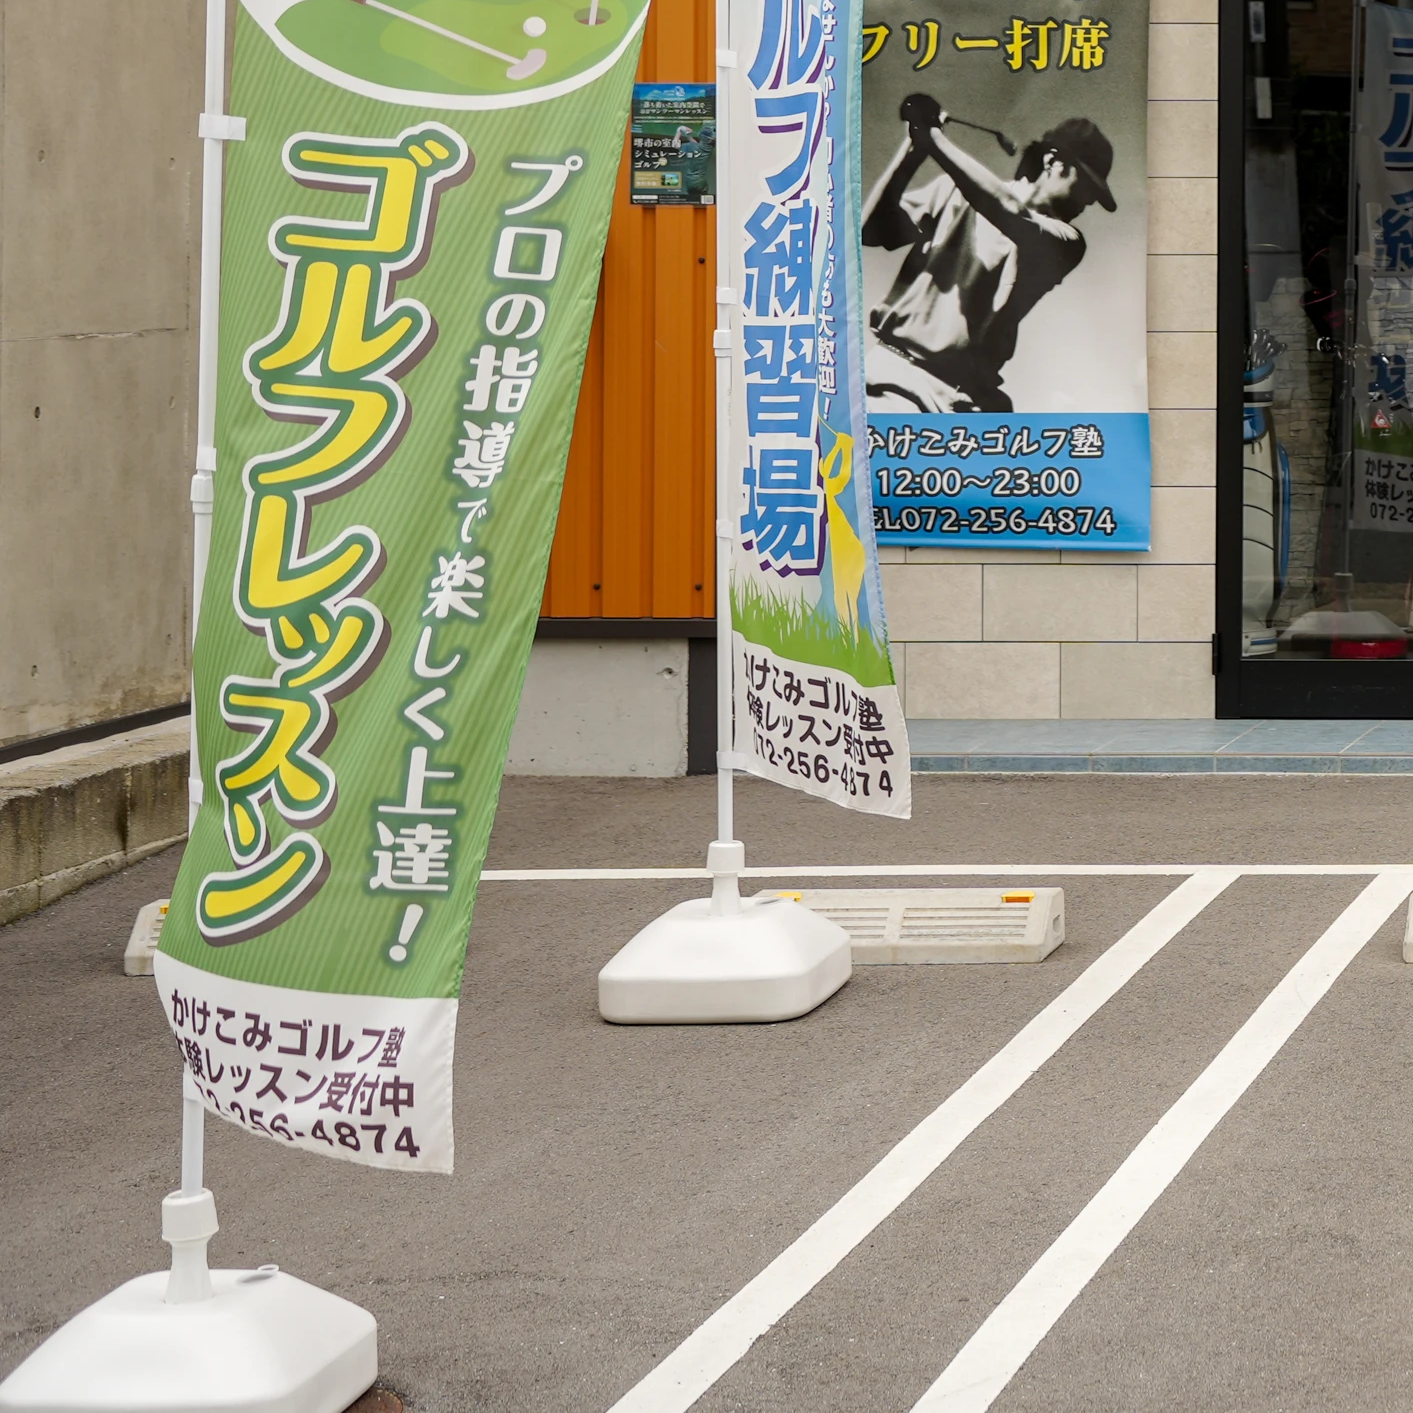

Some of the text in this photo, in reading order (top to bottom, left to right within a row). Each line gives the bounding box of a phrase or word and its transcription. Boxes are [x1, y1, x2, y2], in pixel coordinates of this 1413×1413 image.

[862, 14, 1111, 72] フリー打席
[867, 423, 1104, 459] かけこみゴルフ塾
[197, 122, 470, 938] ゴルフレッスン
[871, 506, 1118, 535] EL072-256-4874
[370, 153, 585, 960] プロの指導で楽しく上達!
[171, 988, 406, 1068] かけこみゴルフ塾
